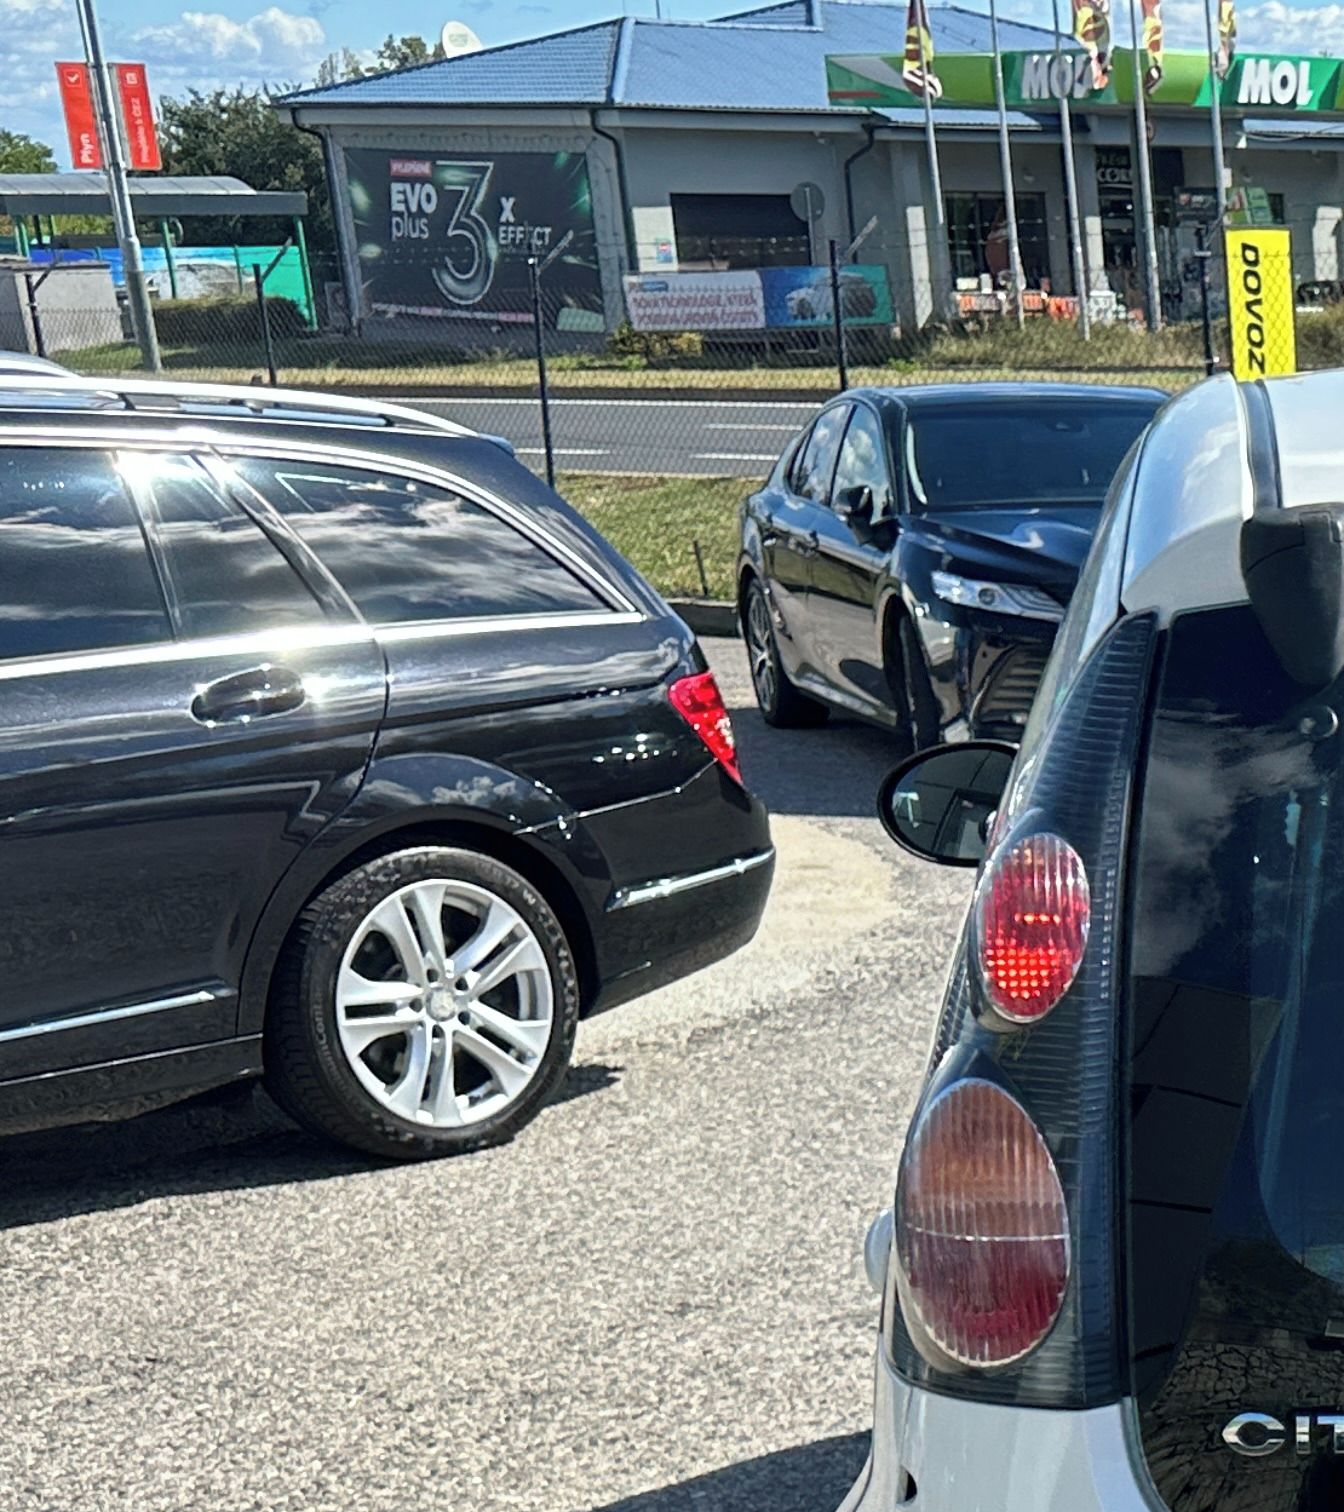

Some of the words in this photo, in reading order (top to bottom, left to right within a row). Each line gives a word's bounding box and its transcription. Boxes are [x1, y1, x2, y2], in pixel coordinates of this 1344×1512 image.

[1237, 58, 1314, 105] MOL
[391, 182, 437, 214] EVO
[391, 210, 429, 242] plus
[431, 160, 494, 305] 3
[1241, 242, 1266, 375] DOVOZ
